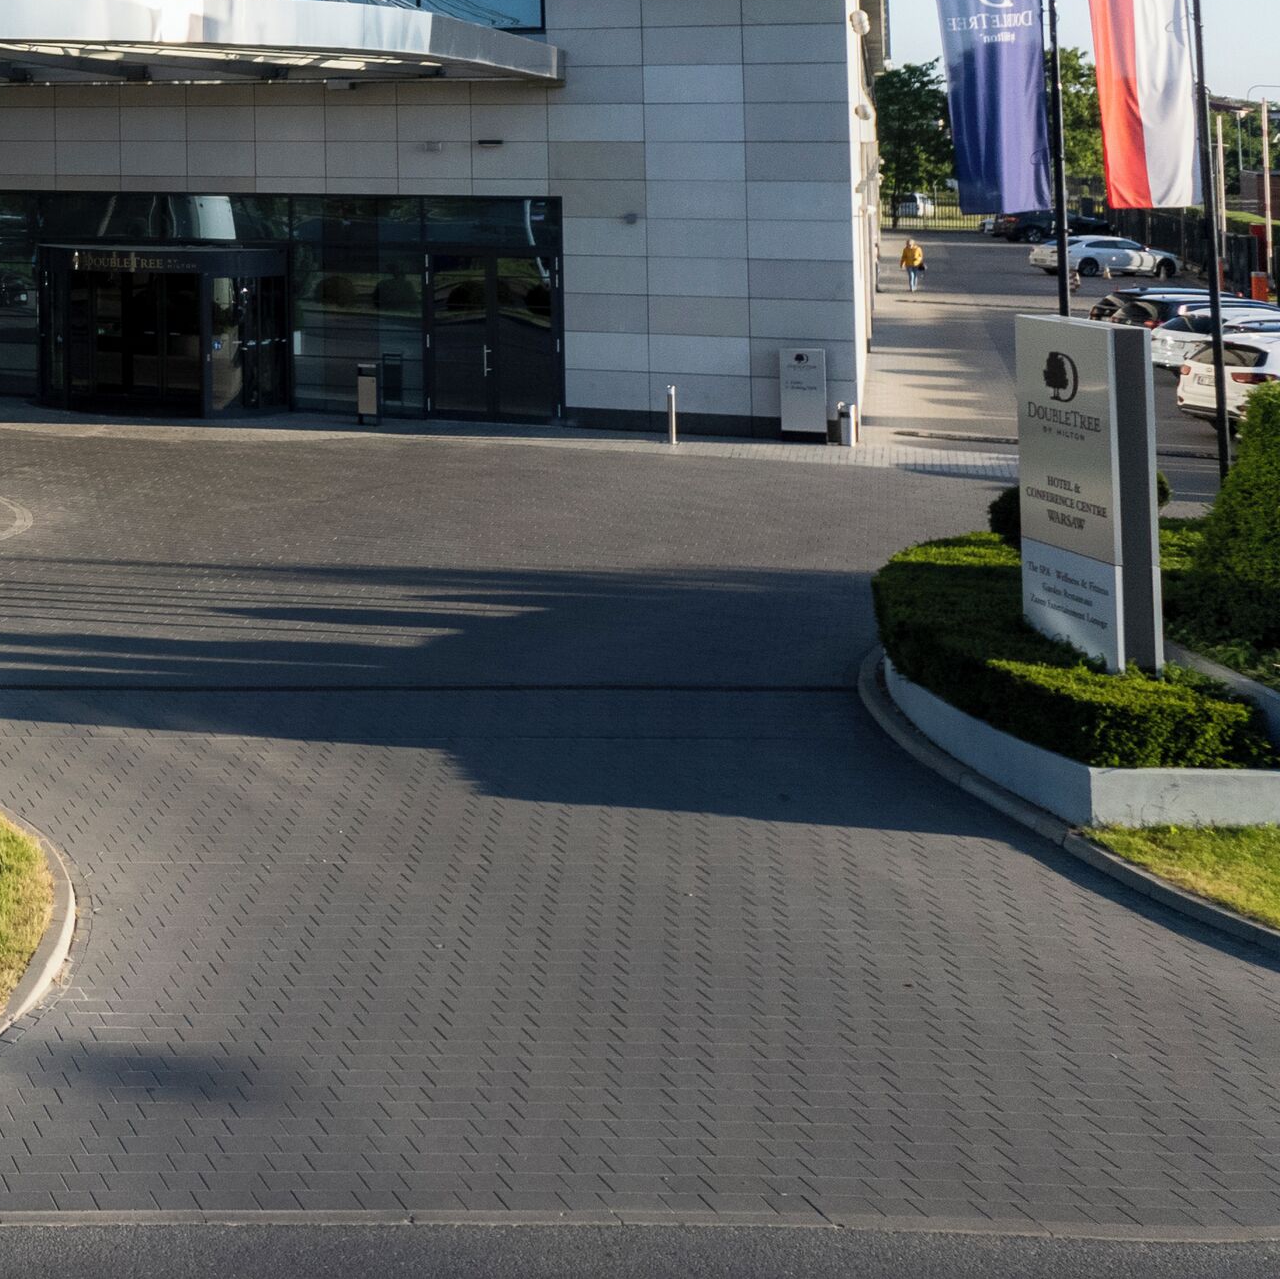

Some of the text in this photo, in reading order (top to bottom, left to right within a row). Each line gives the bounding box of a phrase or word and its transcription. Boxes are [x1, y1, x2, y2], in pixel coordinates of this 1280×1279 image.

[1028, 401, 1101, 433] DOUBLETREE
[1057, 428, 1085, 440] HILTON
[1047, 476, 1073, 491] HOTEL
[1026, 486, 1107, 518] CONFERENCE CENTRE
[1047, 509, 1085, 530] WARSAW
